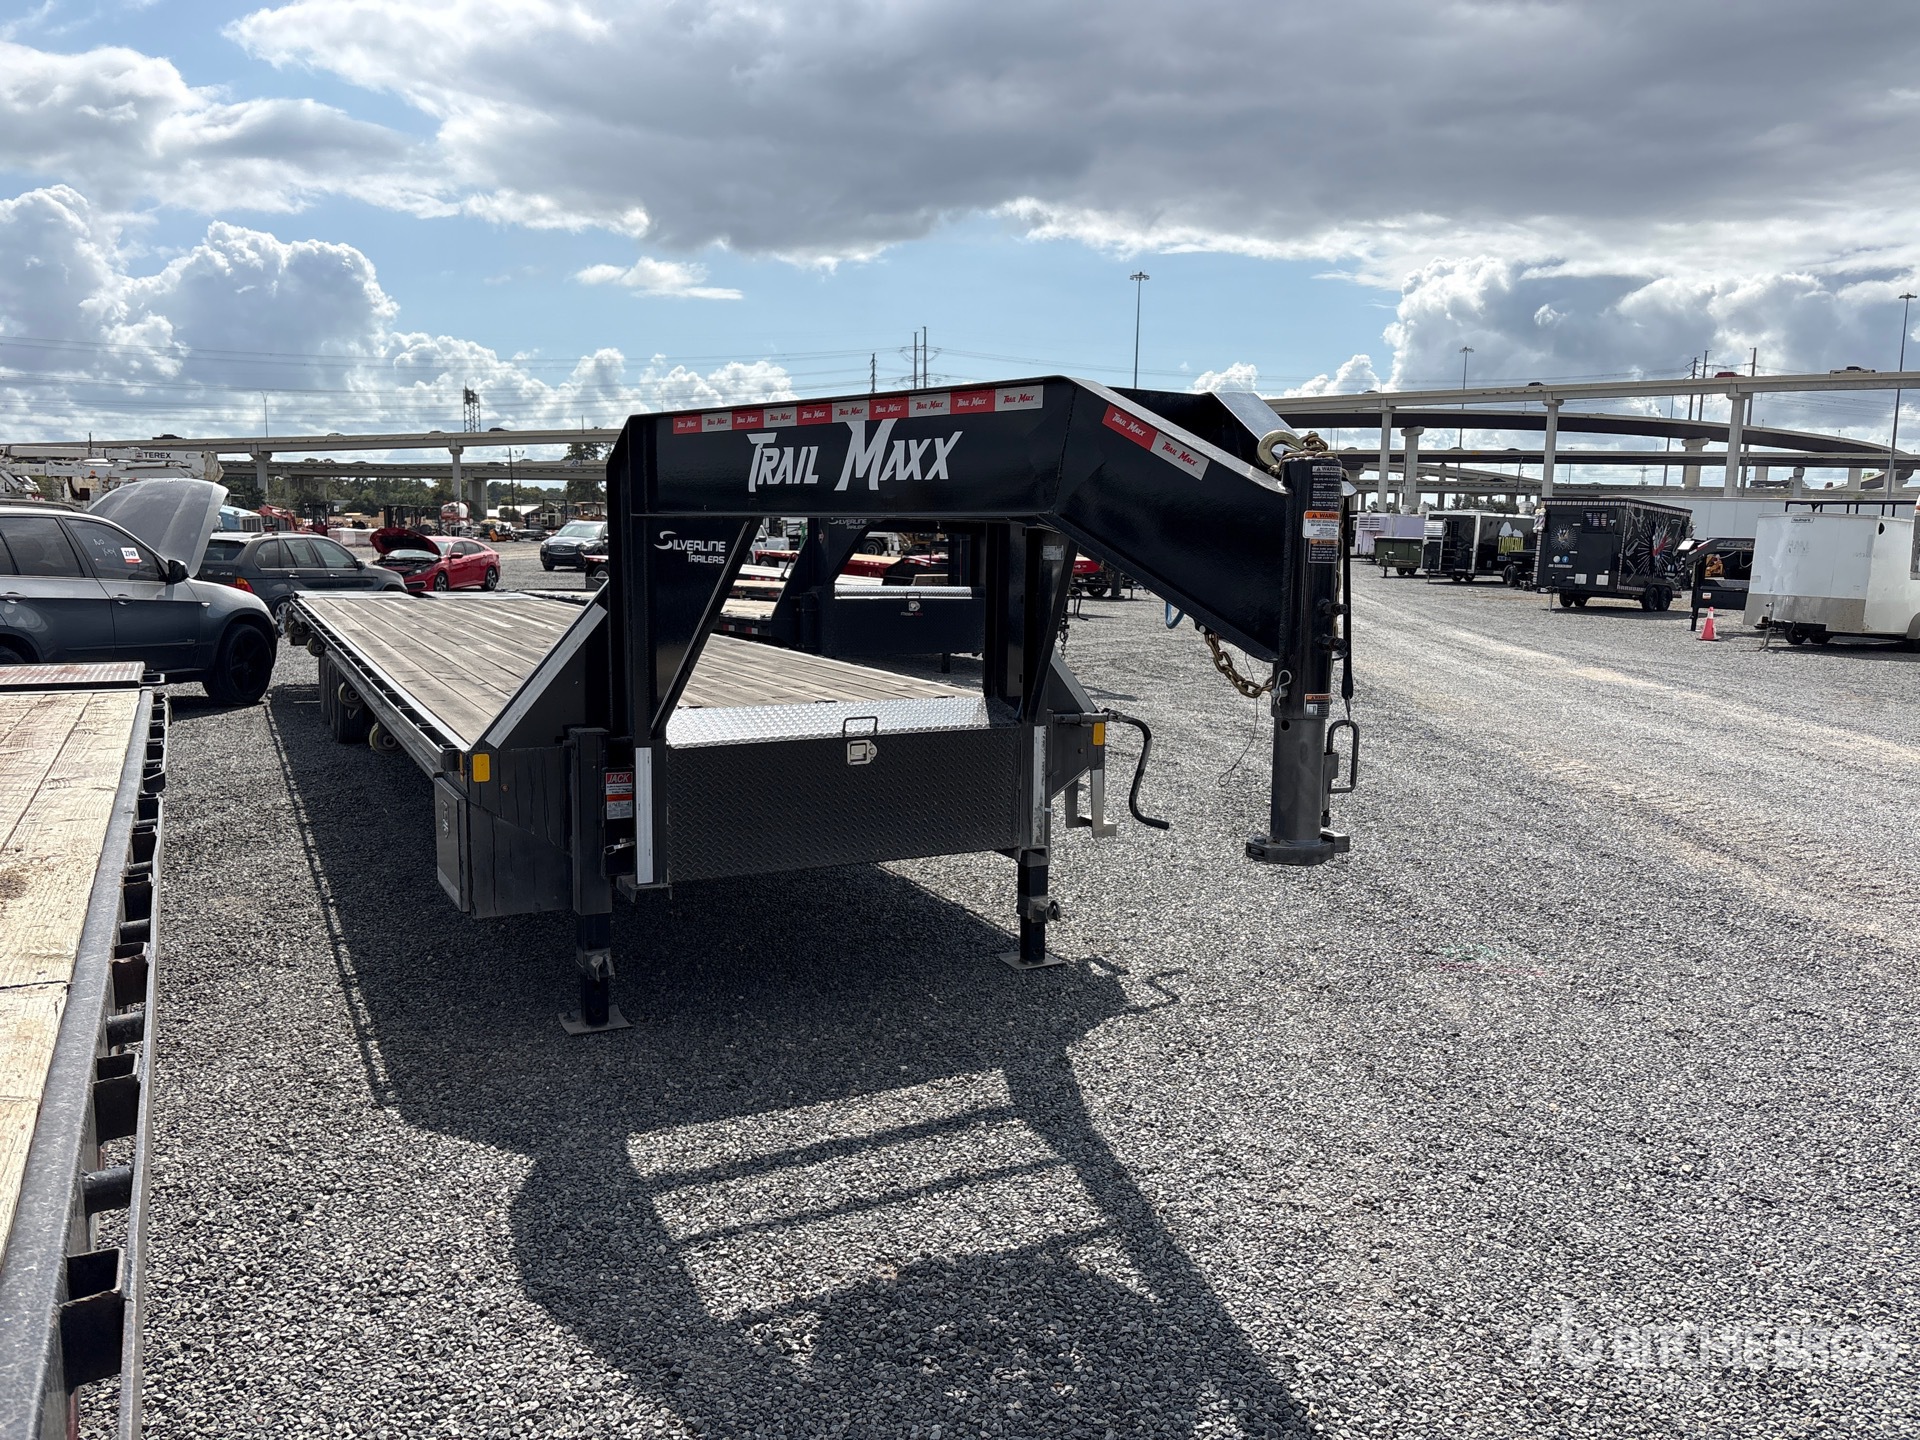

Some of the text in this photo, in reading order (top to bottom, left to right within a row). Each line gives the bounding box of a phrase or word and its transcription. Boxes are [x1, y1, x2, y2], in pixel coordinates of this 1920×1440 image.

[1112, 413, 1146, 436] TRAIL MAXX
[143, 451, 172, 459] TEREX
[746, 418, 963, 493] TRAIL MAXX
[1162, 442, 1197, 466] TRAIL MAXX
[653, 530, 726, 552] SILVERLINE
[686, 551, 726, 564] TRAILERS
[608, 774, 630, 783] JACK
